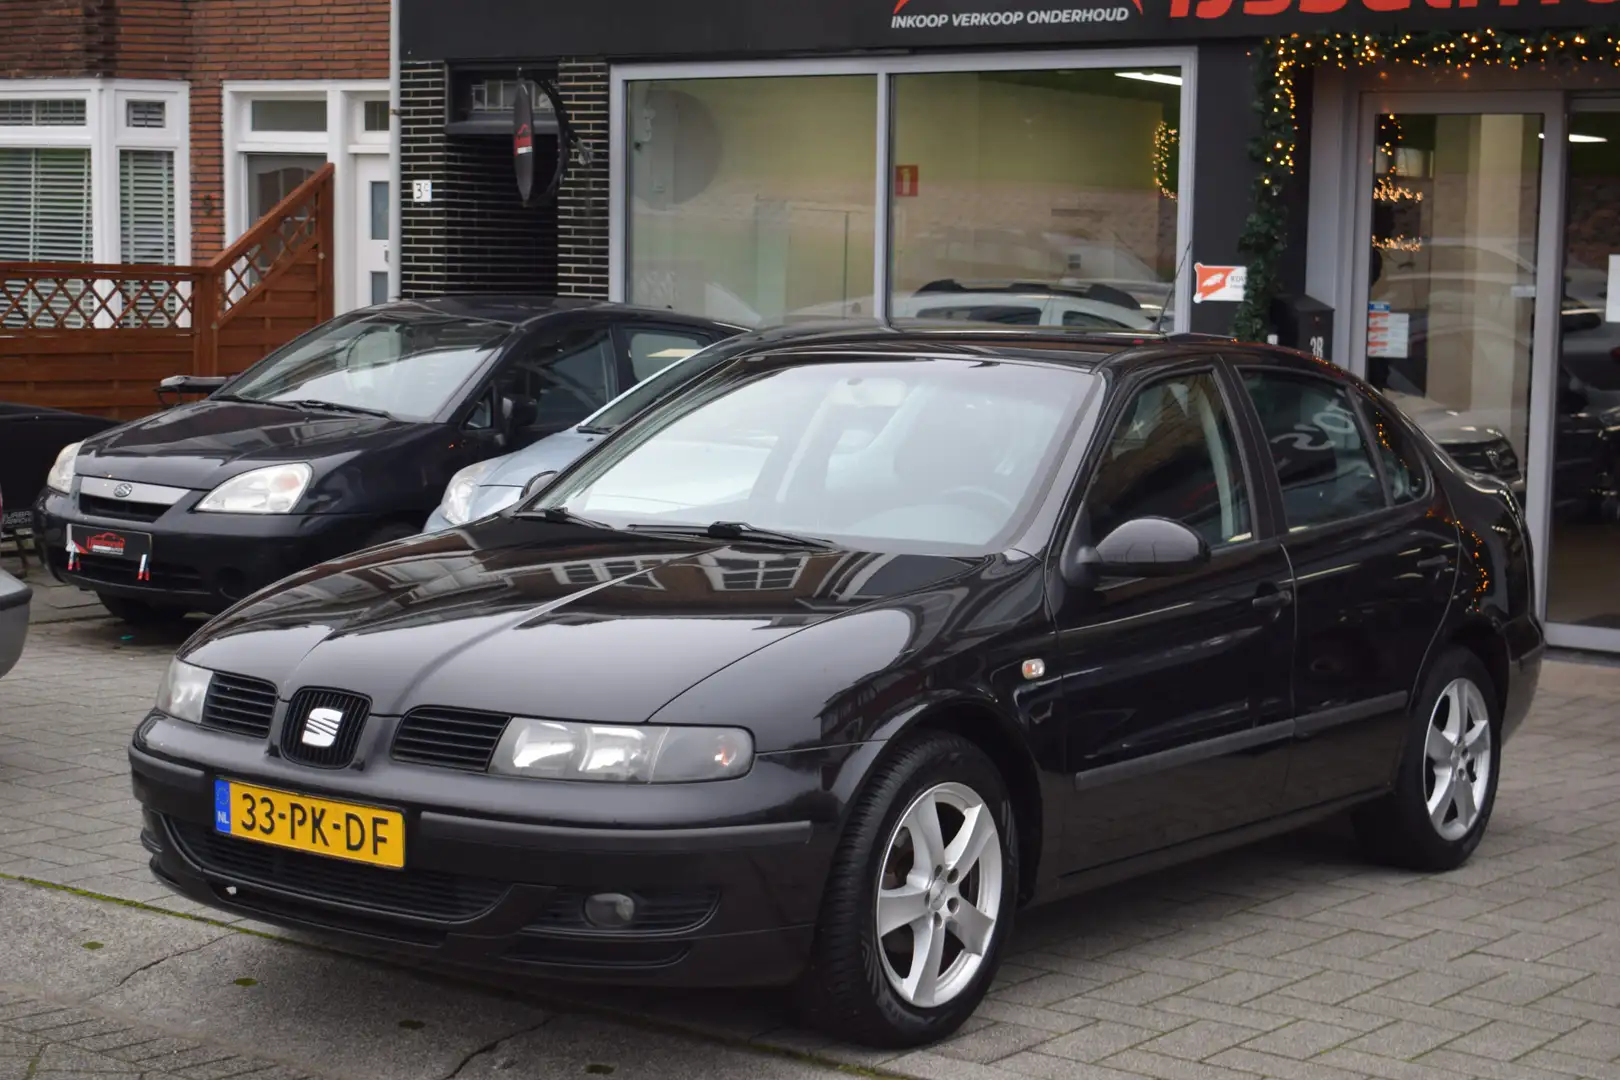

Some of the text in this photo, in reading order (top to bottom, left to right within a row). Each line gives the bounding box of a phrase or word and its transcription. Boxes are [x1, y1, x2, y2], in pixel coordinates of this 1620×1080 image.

[891, 7, 1130, 29] INKOOP VERKOOP ONDERHOUD
[217, 811, 230, 824] NL
[241, 793, 389, 855] 33-PK-DF
